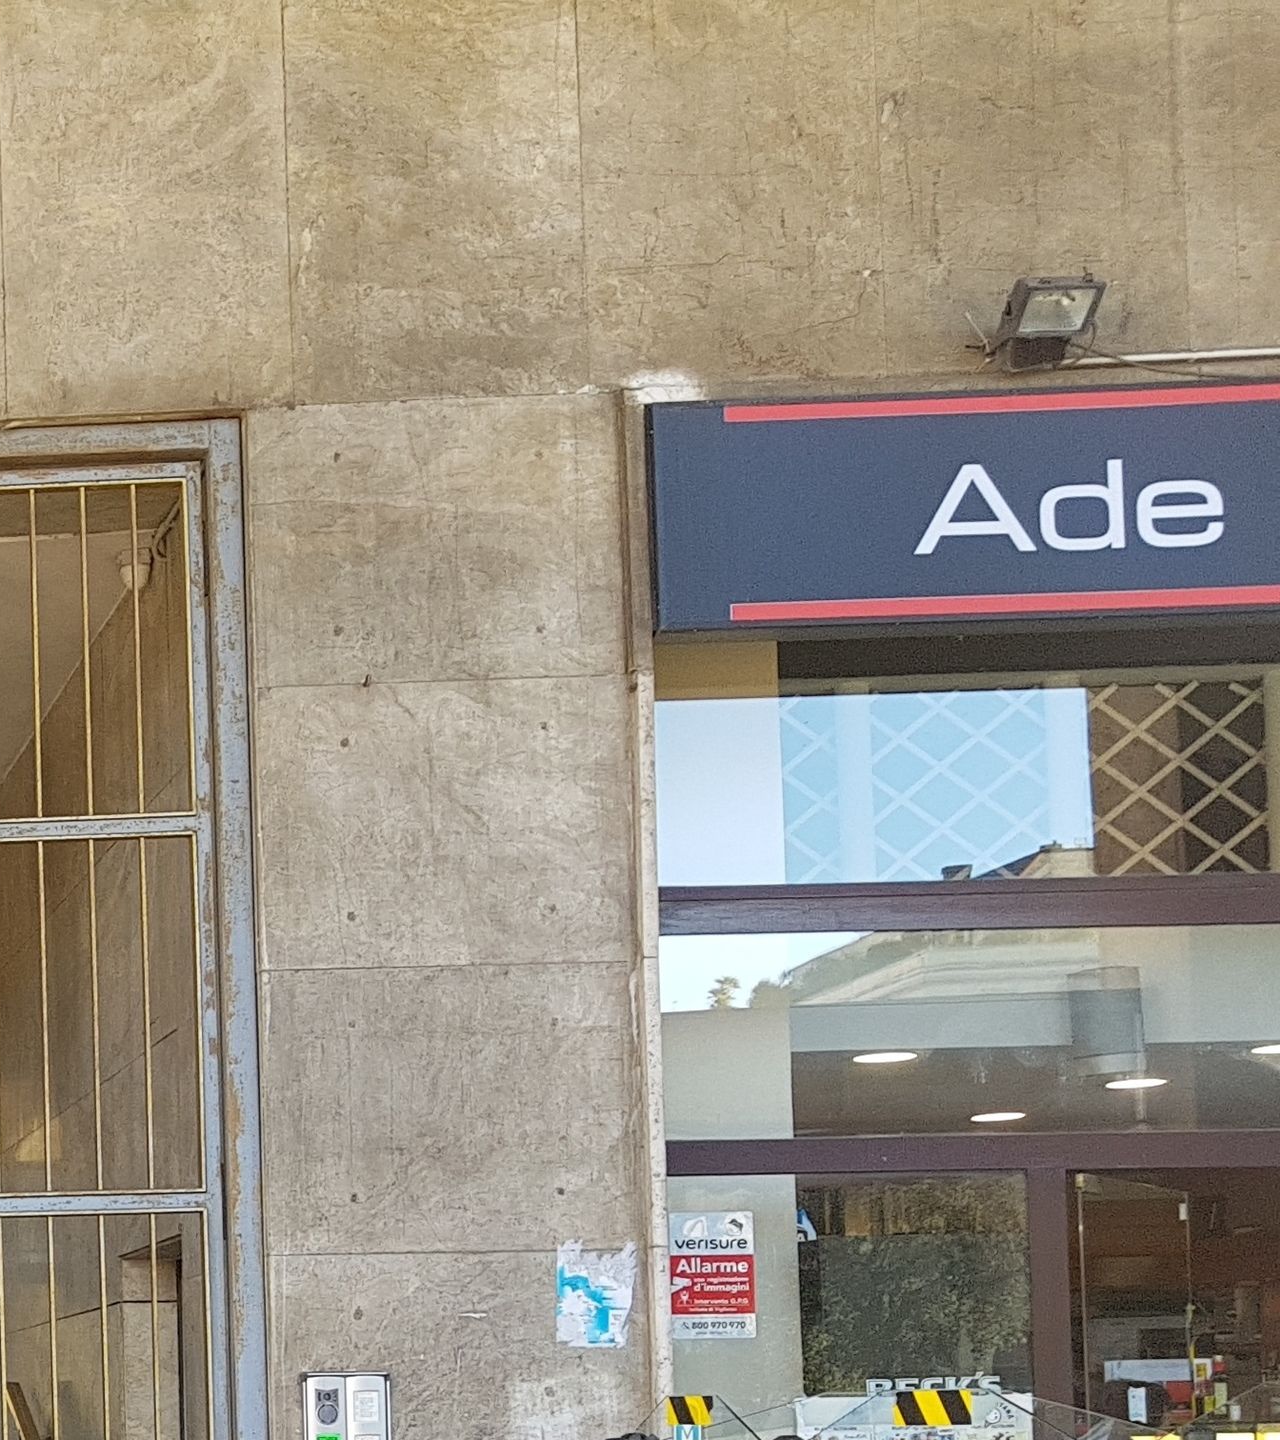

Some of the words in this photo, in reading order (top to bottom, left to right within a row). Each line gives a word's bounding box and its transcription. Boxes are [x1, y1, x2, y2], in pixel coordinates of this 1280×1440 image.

[913, 459, 1225, 555] Ade
[674, 1237, 749, 1250] verisure
[676, 1256, 749, 1274] Allarme
[693, 1282, 750, 1294] d'immagini
[711, 1320, 728, 1330] 970
[729, 1320, 747, 1329] 970
